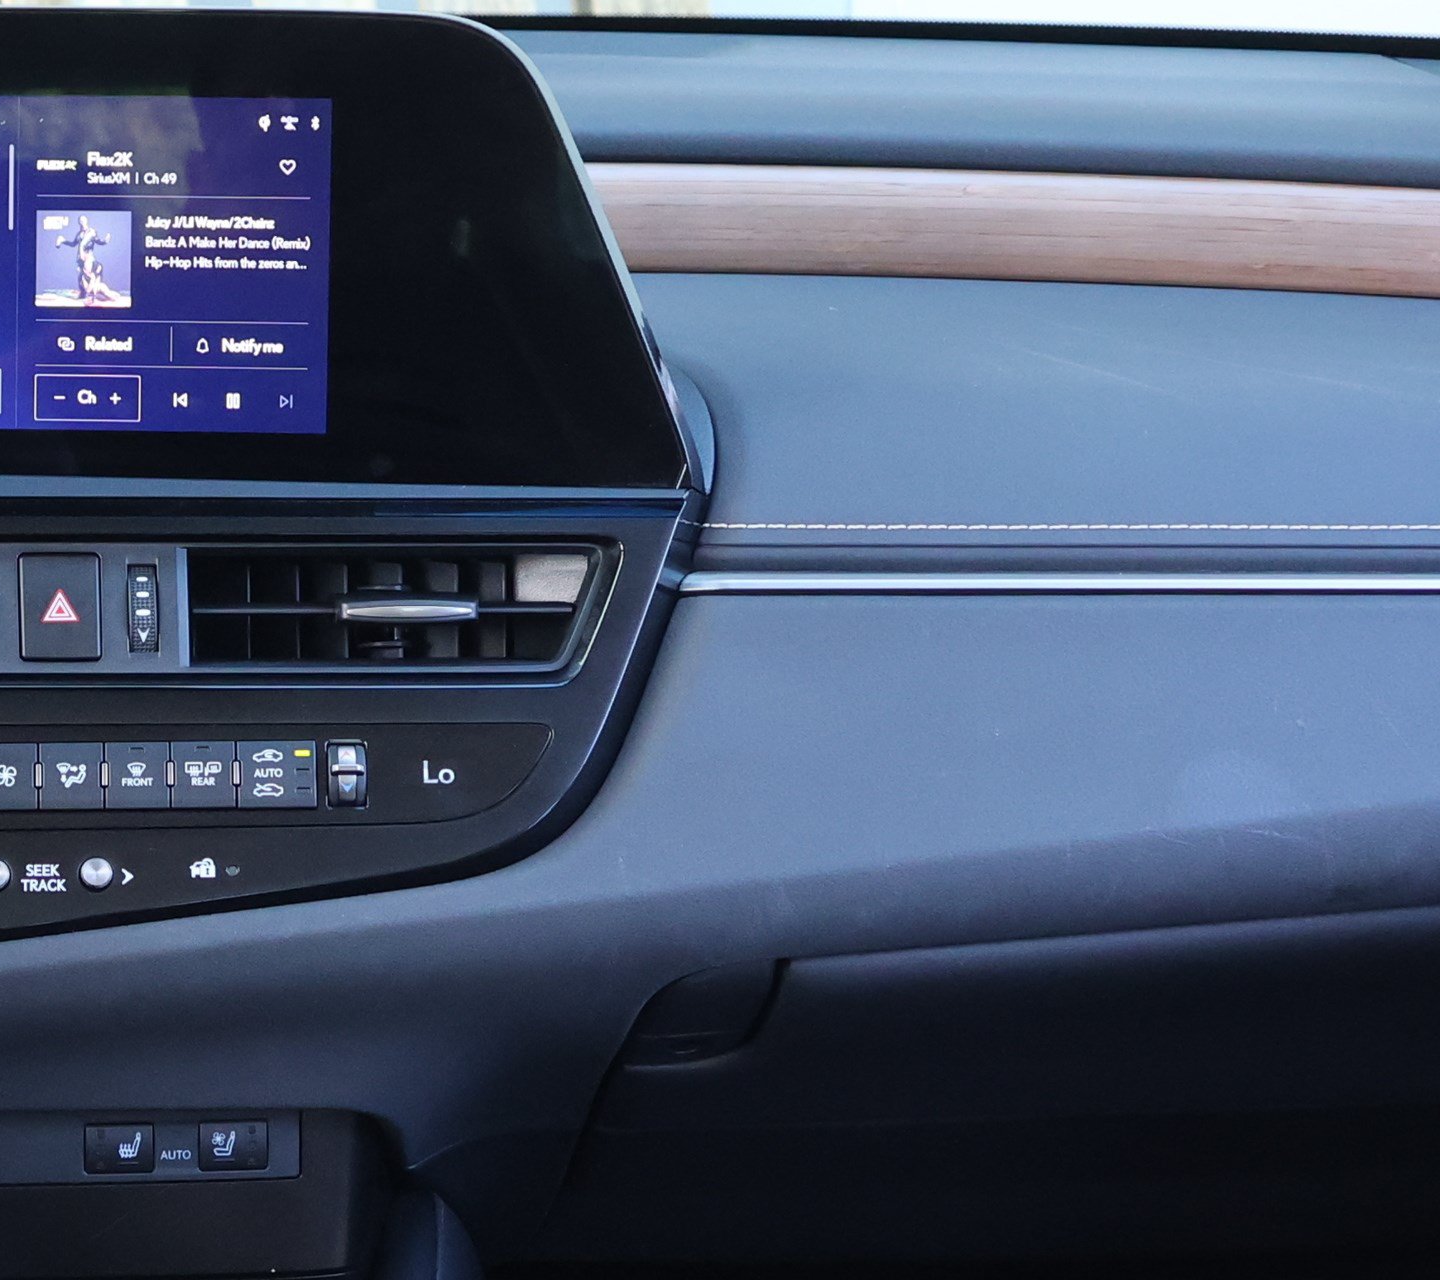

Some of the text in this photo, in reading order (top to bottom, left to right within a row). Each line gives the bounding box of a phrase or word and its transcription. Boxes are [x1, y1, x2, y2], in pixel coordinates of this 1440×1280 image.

[87, 150, 133, 168] Flex2K
[87, 171, 177, 185] SiriusXM Ch 49
[145, 236, 311, 251] Bandz A Make Her Dance (Remix)
[145, 256, 192, 270] Hip-Hop
[193, 256, 213, 269] Hits
[214, 256, 238, 269] from
[240, 256, 256, 269] the
[258, 259, 284, 270] zeros
[85, 336, 133, 352] Related
[221, 337, 284, 356] Notify me
[77, 388, 97, 404] Ch
[254, 767, 283, 778] AUTO
[421, 759, 456, 785] Lo
[121, 777, 153, 788] FRONT
[190, 776, 216, 787] REAR
[26, 863, 60, 878] SEEK
[20, 878, 67, 893] TRACK
[160, 1149, 192, 1161] AUTO
